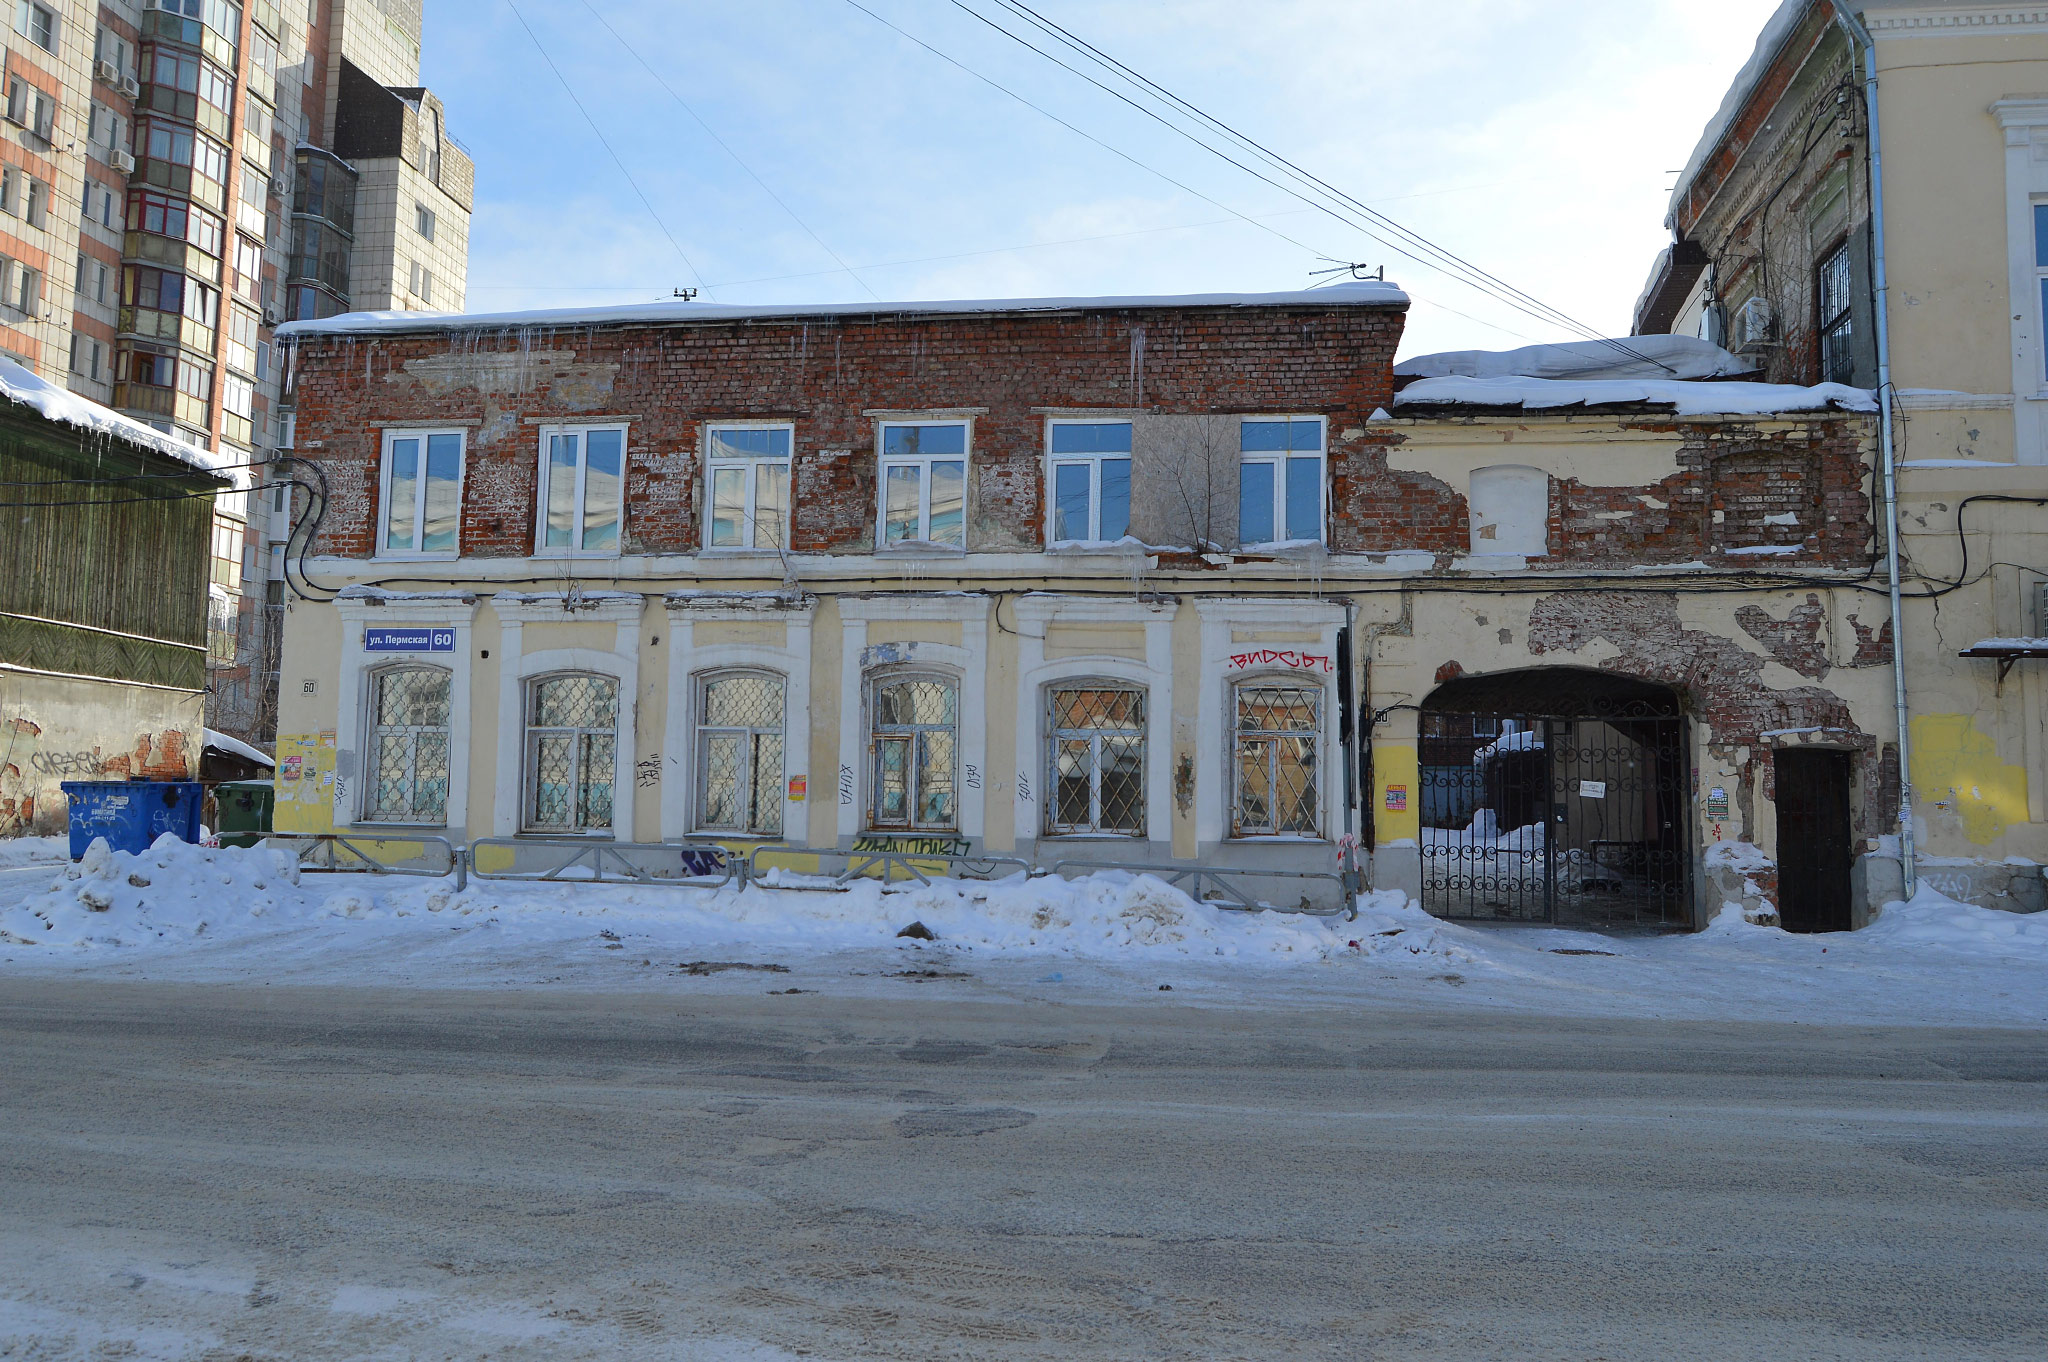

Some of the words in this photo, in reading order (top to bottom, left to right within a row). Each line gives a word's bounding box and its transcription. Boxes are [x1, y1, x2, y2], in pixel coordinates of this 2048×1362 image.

[369, 635, 383, 646] ул.
[385, 634, 428, 646] Пермская
[434, 633, 452, 646] 60
[303, 682, 315, 693] 60
